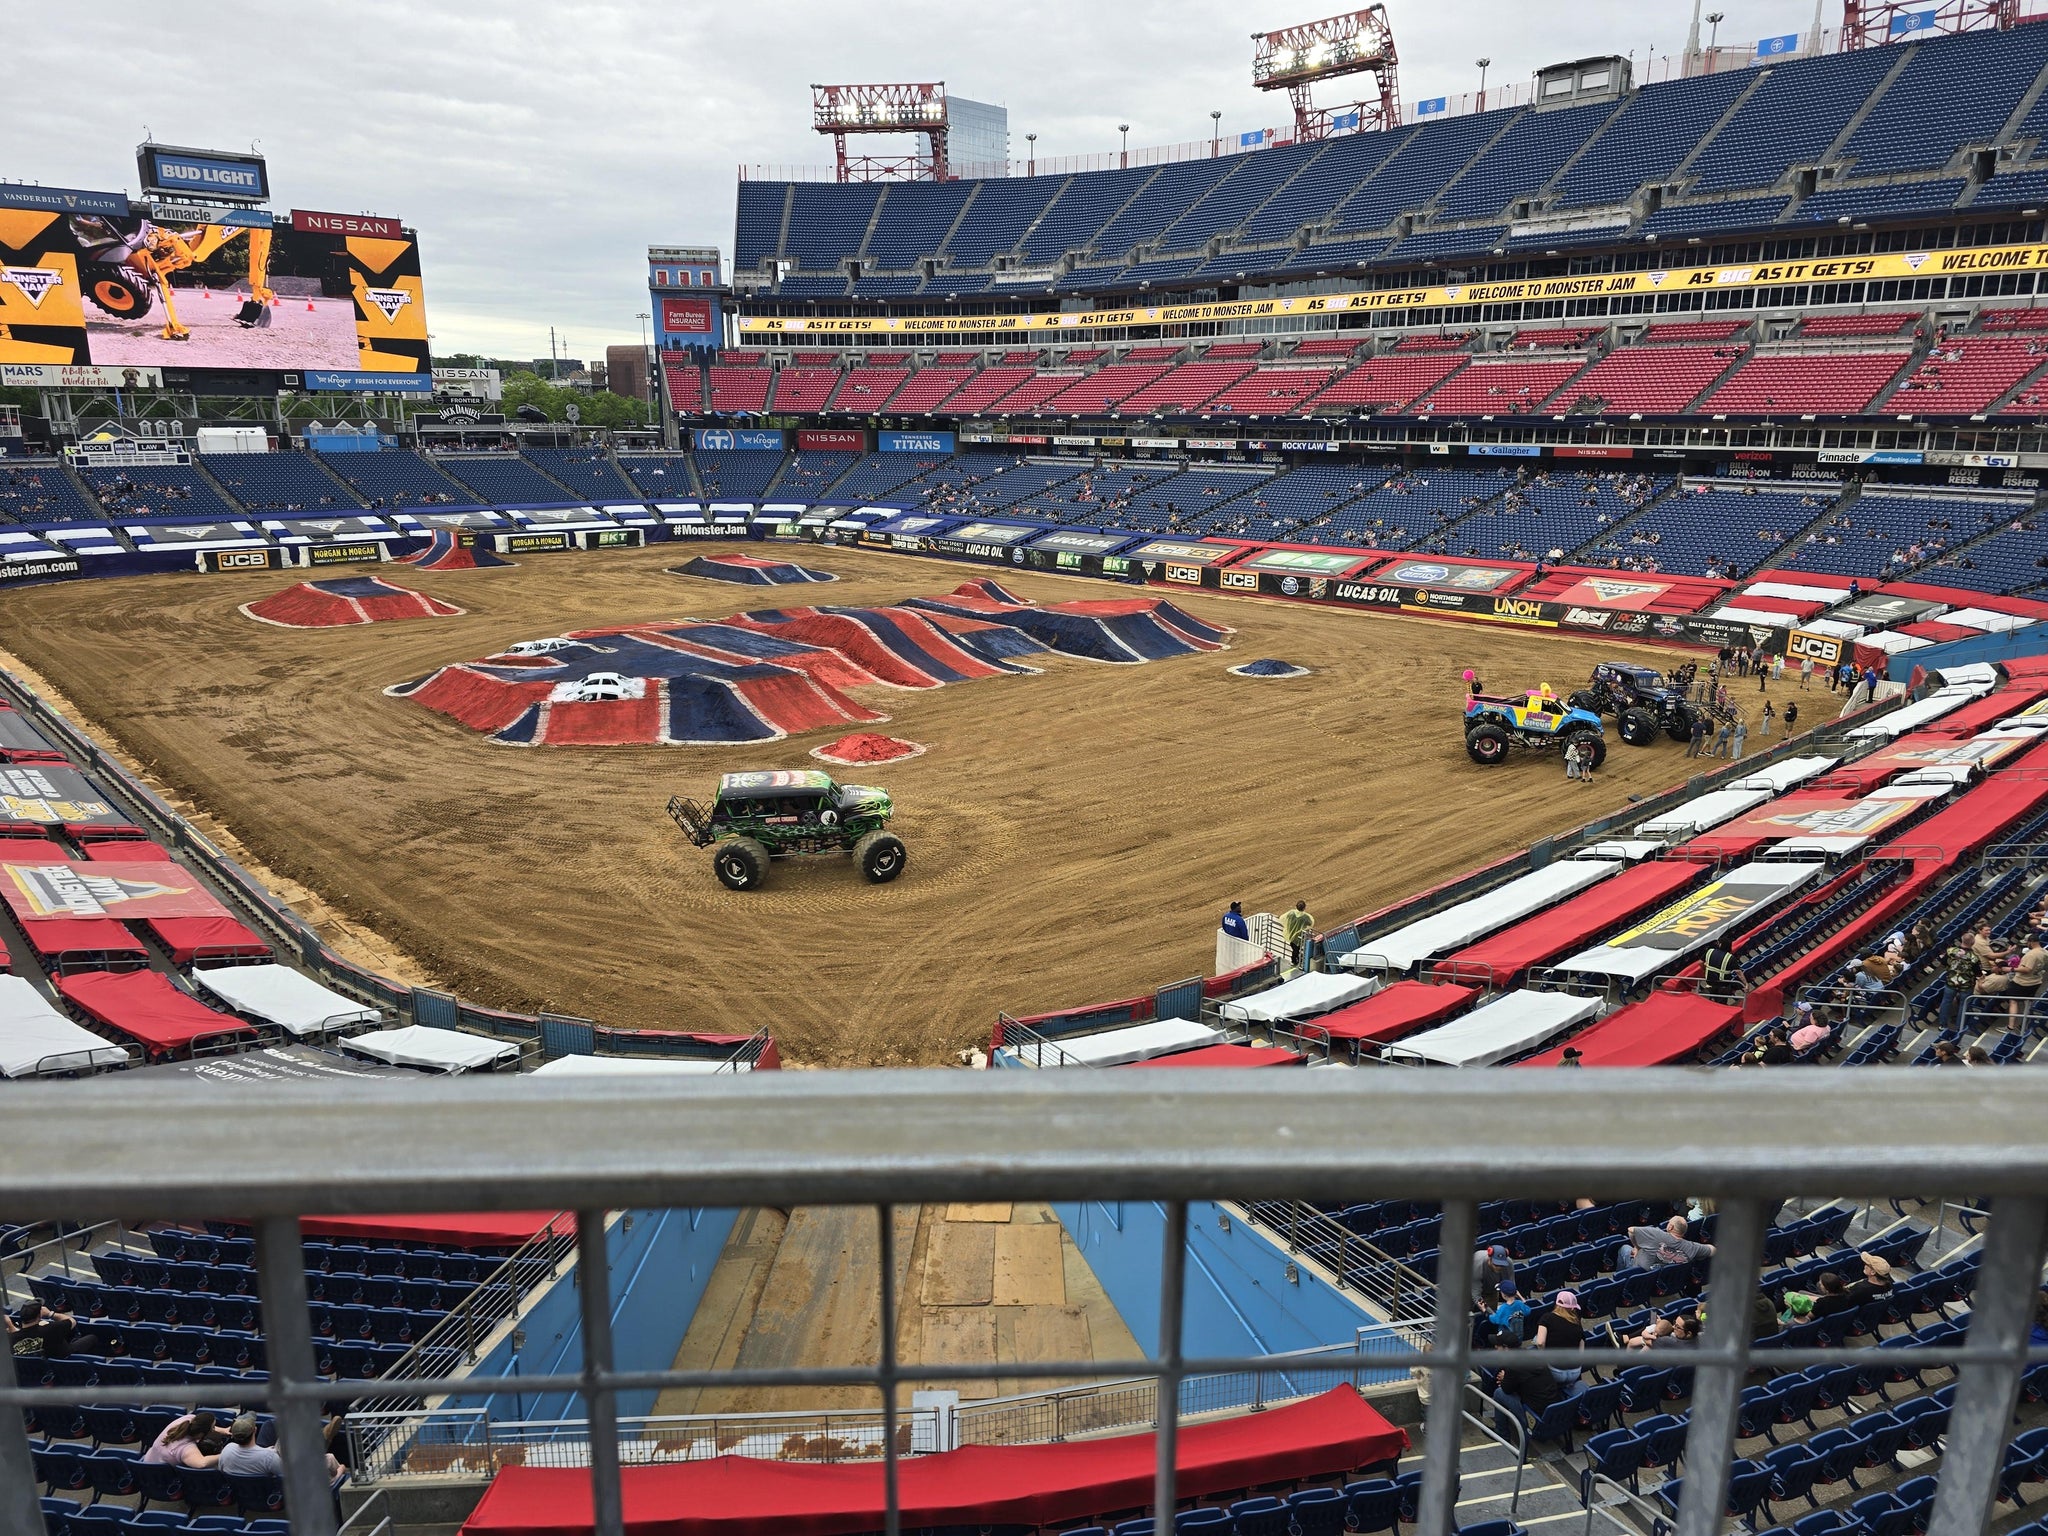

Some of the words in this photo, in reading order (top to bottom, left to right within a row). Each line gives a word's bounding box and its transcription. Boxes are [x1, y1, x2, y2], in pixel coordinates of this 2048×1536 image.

[161, 164, 201, 180] BUD
[202, 168, 255, 186] LIGHT
[4, 193, 62, 204] VANDERBILT
[80, 200, 116, 208] HEALTH
[154, 205, 211, 221] Pinnacle
[307, 216, 388, 234] NISSAN
[1942, 250, 2032, 269] WELCOME
[2036, 249, 2048, 264] T
[1, 273, 63, 285] MONSTER
[1688, 271, 1715, 285] AS
[1717, 268, 1752, 283] BIG
[1754, 267, 1780, 281] AS
[1784, 265, 1804, 278] IT
[1811, 261, 1875, 277] GETS!
[19, 283, 48, 292] JAM
[1468, 283, 1524, 300] WELCOME
[1527, 283, 1542, 296] TO
[1543, 279, 1604, 295] MONSTER
[1606, 277, 1636, 291] JAM
[365, 293, 412, 304] MONSTER
[1307, 299, 1324, 310] AS
[1326, 298, 1349, 309] BIG
[1350, 297, 1368, 308] AS
[1369, 295, 1382, 306] IT
[1387, 292, 1427, 305] GETS!
[379, 301, 401, 309] JAM
[1162, 307, 1200, 319] WELCOME
[1201, 307, 1211, 317] TO
[1213, 304, 1253, 317] MONSTER
[1254, 303, 1273, 314] JAM
[767, 321, 783, 329] AS
[807, 321, 823, 329] AS
[824, 321, 836, 329] IT
[839, 321, 871, 329] GETS!
[904, 321, 944, 330] WELCOME
[946, 320, 957, 329] TO
[959, 319, 996, 328] MONSTER
[998, 318, 1016, 328] JAM
[1045, 317, 1059, 325] AS
[1080, 315, 1094, 324] AS
[1095, 315, 1104, 323] IT
[1107, 313, 1134, 323] GETS!
[4, 366, 43, 376] MARS
[431, 369, 489, 378] NISSAN
[62, 377, 85, 385] World
[328, 374, 351, 387] Kroger
[439, 407, 456, 420] JACK
[753, 433, 779, 448] Kroger
[806, 434, 856, 442] NISSAN
[893, 440, 941, 450] TITANS
[1282, 442, 1307, 450] ROCKY
[1308, 442, 1324, 450] LAW
[1491, 446, 1530, 456] Gallagher
[1735, 452, 1772, 461] verizon
[1819, 452, 1860, 462] Pinnacle
[1872, 456, 1922, 464] TitansBanking.com
[1984, 456, 2011, 466] tsu
[1792, 463, 1817, 471] MIKE
[1950, 468, 1981, 477] FLOYD
[2004, 470, 2025, 478] JEFF
[1948, 476, 1979, 485] REESE
[2002, 478, 2039, 487] FISHER
[673, 524, 747, 536] #MonsterJam
[776, 523, 801, 535] BKT
[540, 537, 562, 545] MORGAN
[598, 532, 628, 544] BKT
[314, 549, 341, 558] MORGAN
[348, 547, 375, 555] MORGAN
[965, 543, 990, 556] LUCAS
[222, 553, 266, 567] JCB
[1056, 552, 1082, 567] BKT
[1103, 556, 1130, 571] BKT
[0, 561, 78, 578] sterJam.com
[1168, 567, 1199, 581] JCB
[1223, 575, 1256, 588] JCB
[1336, 583, 1378, 600] LUCAS
[1430, 593, 1463, 602] NORTHERN
[1493, 597, 1542, 616] UNOH
[1618, 613, 1635, 622] RC
[1613, 622, 1645, 632] CARS
[1748, 628, 1773, 638] MONSTER
[1792, 637, 1839, 660] JCB
[679, 815, 694, 834] JCB
[38, 865, 107, 915] MONSTER
[77, 876, 130, 901] JAM
